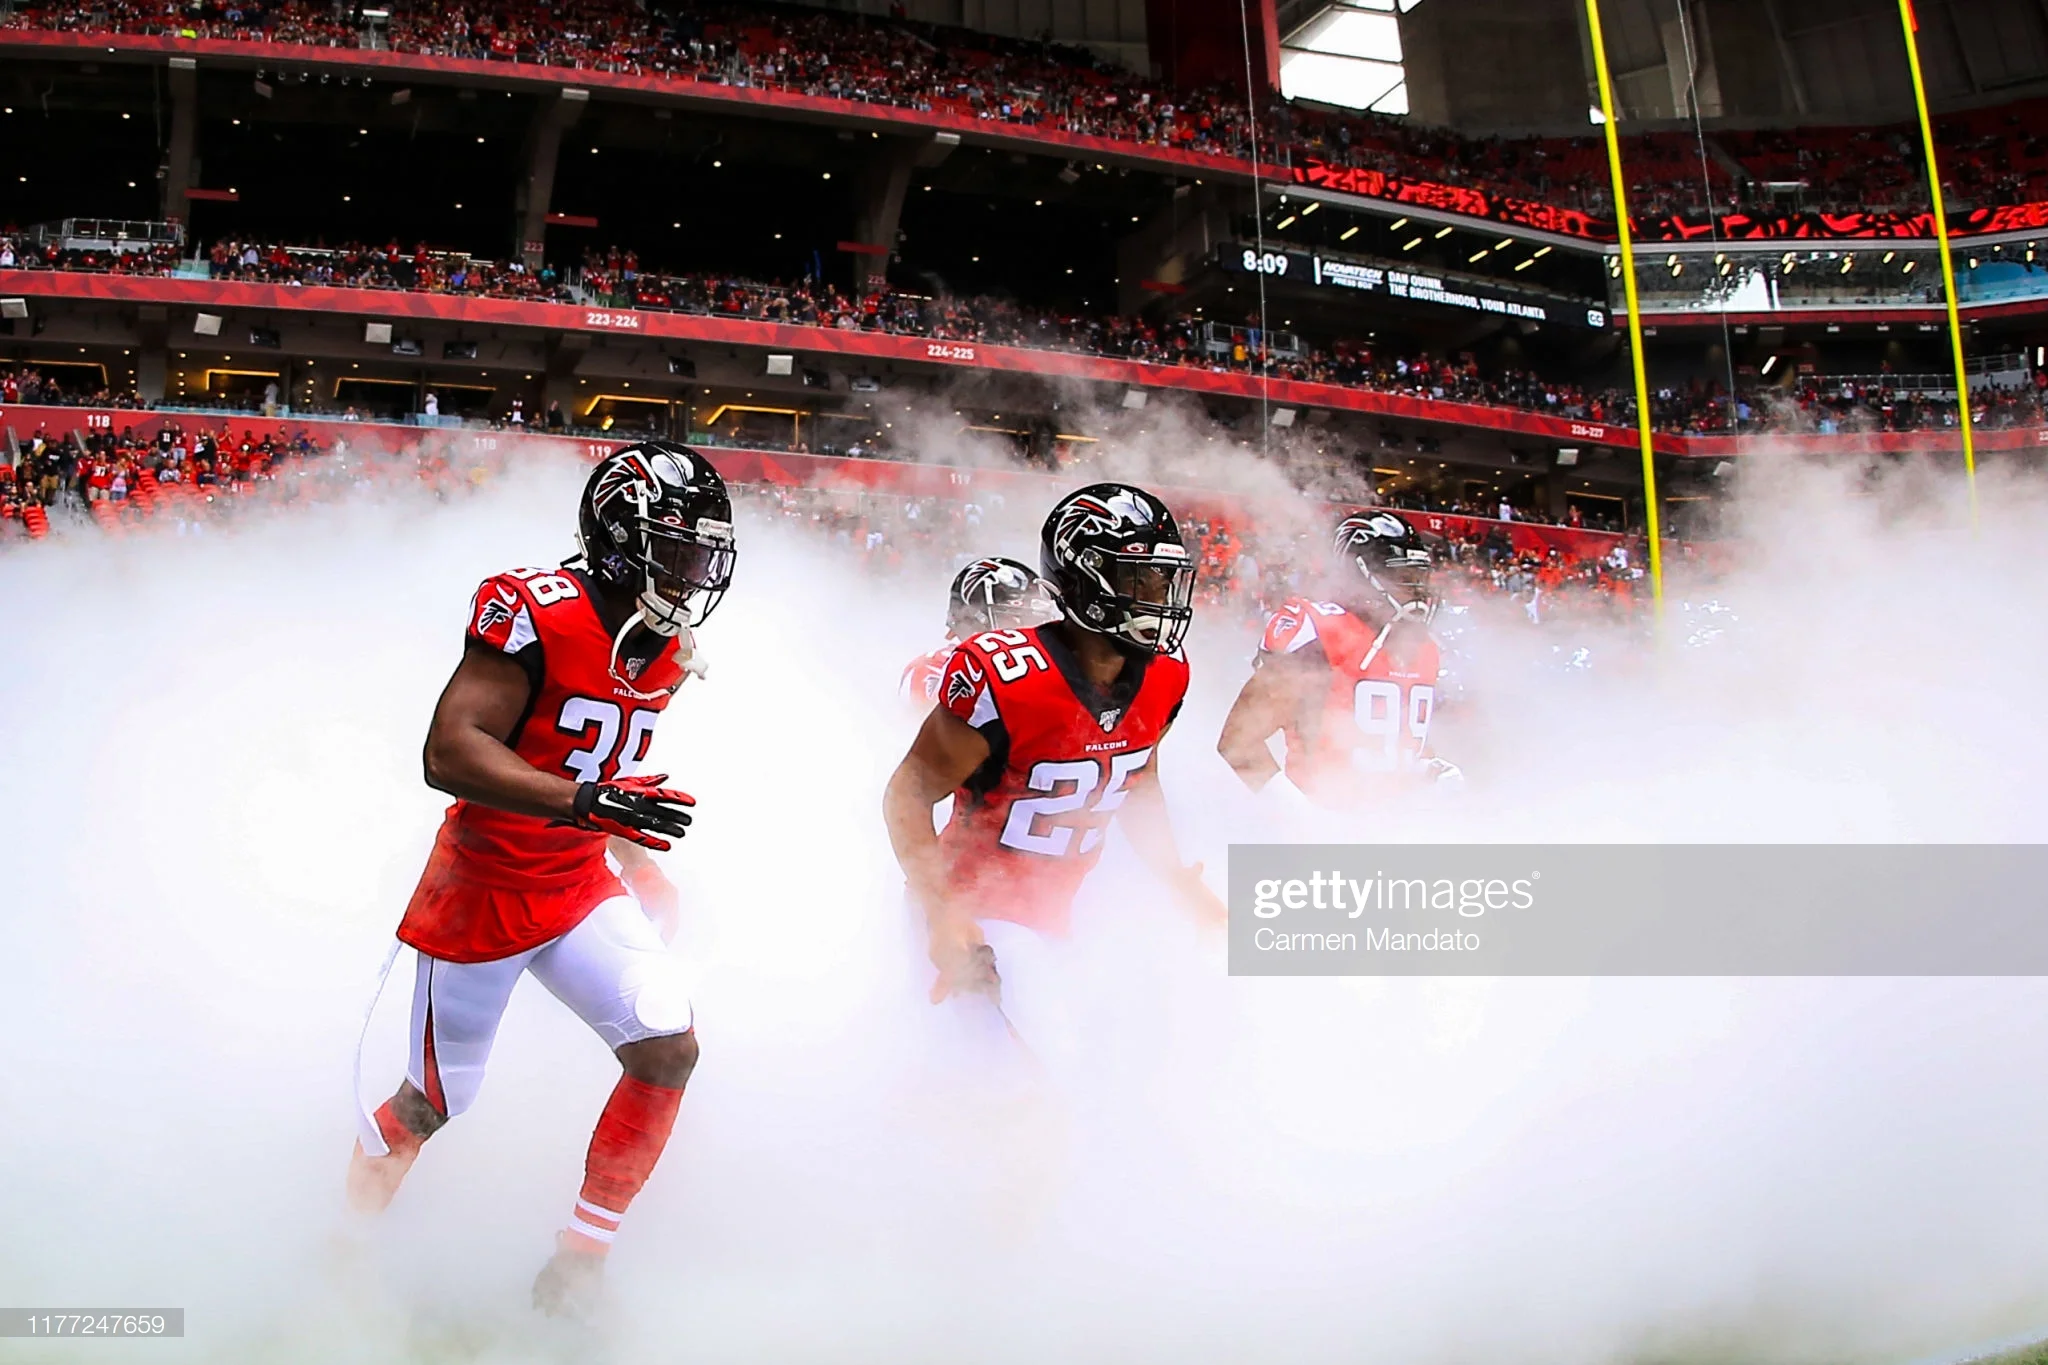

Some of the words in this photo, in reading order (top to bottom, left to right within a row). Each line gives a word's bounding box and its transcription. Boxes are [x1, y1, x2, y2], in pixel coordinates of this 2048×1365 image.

[1243, 250, 1289, 275] 8:09
[1387, 271, 1409, 285] DAN
[1388, 283, 1408, 297] THE
[1409, 286, 1480, 310] BROTHERHOOD,
[1480, 298, 1506, 313] YOUR
[1507, 303, 1546, 320] ATLANTA
[587, 312, 639, 328] 223-224
[927, 344, 975, 360] 224-225
[87, 414, 110, 428] 118
[588, 444, 612, 458] 119
[974, 629, 1048, 682] 25
[1354, 680, 1435, 771] 99
[1085, 740, 1128, 752] FALCONS
[1000, 746, 1153, 856] 25
